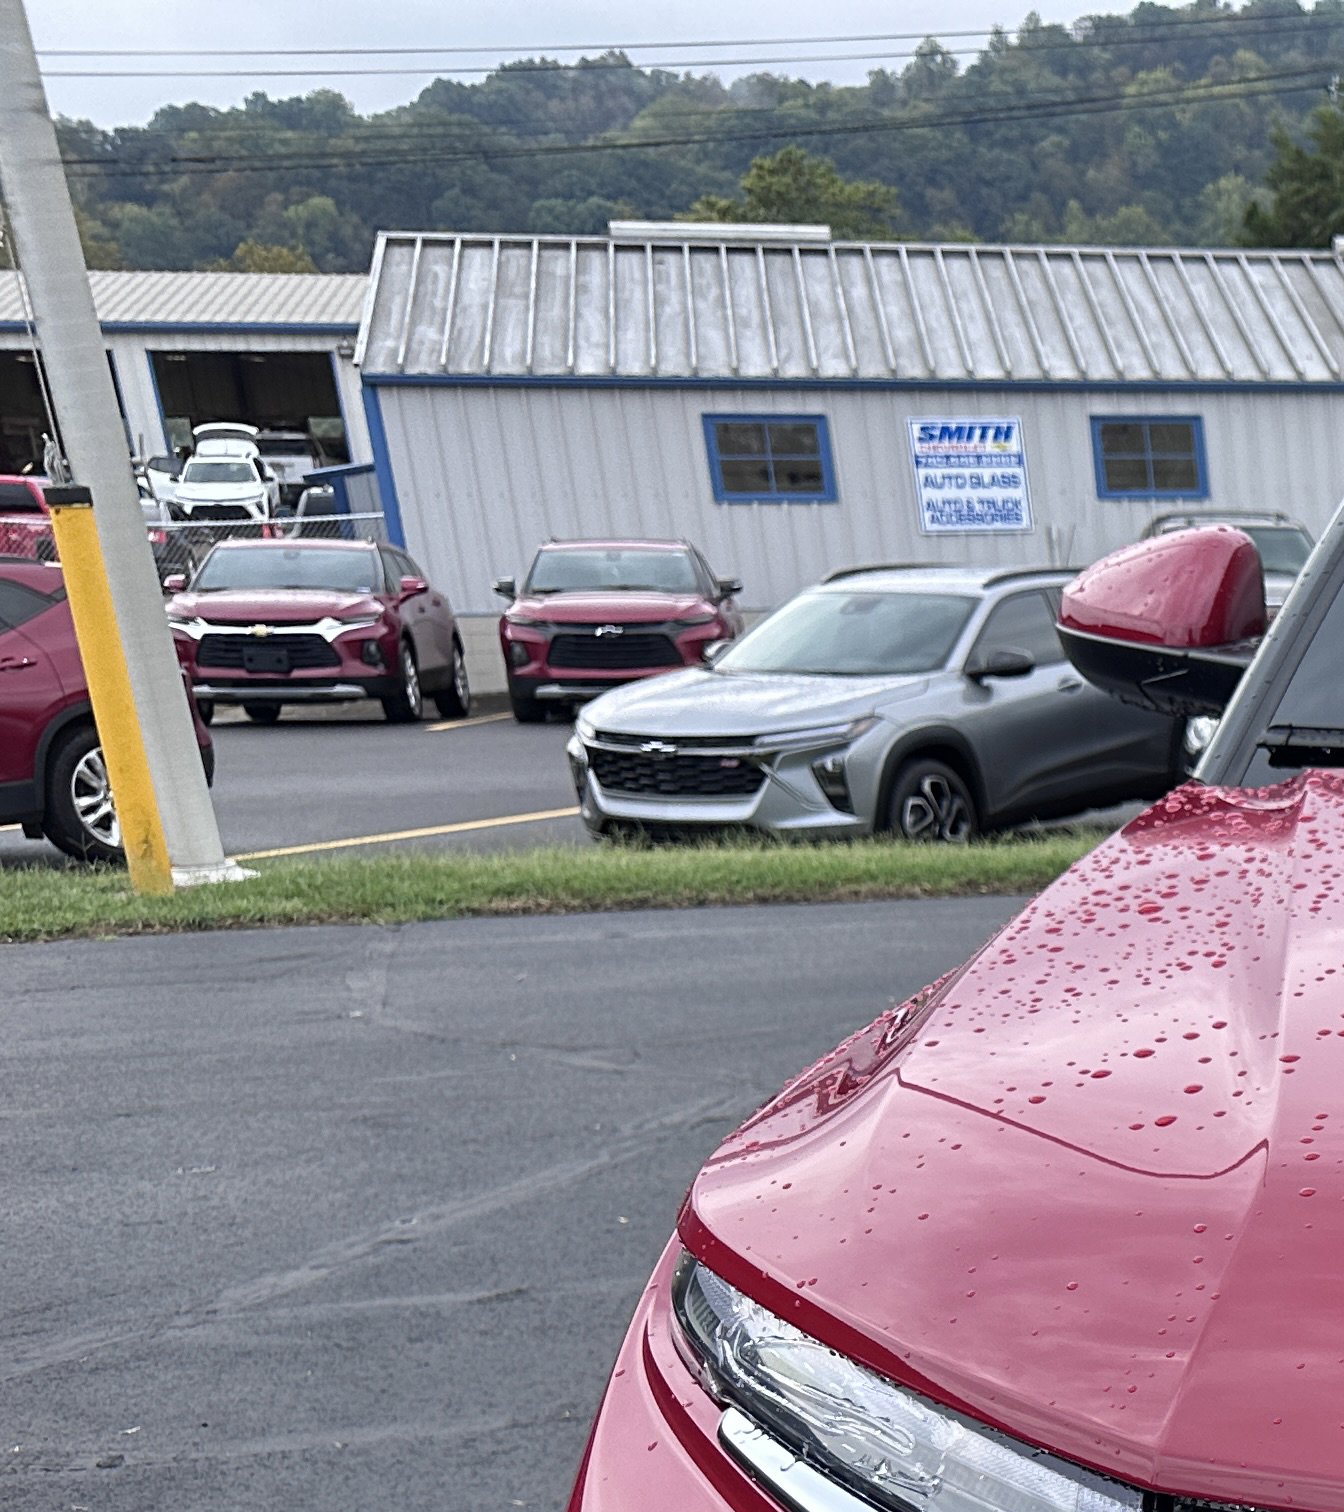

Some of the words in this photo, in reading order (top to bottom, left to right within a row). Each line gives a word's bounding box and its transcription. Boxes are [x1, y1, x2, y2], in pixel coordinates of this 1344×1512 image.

[918, 425, 1013, 443] SMITH
[924, 472, 967, 489] AUTO
[969, 472, 1021, 489] GLASS
[927, 497, 964, 512] AUTO
[977, 497, 1022, 512] TRUCK
[931, 511, 1023, 525] ACCESSORIES
